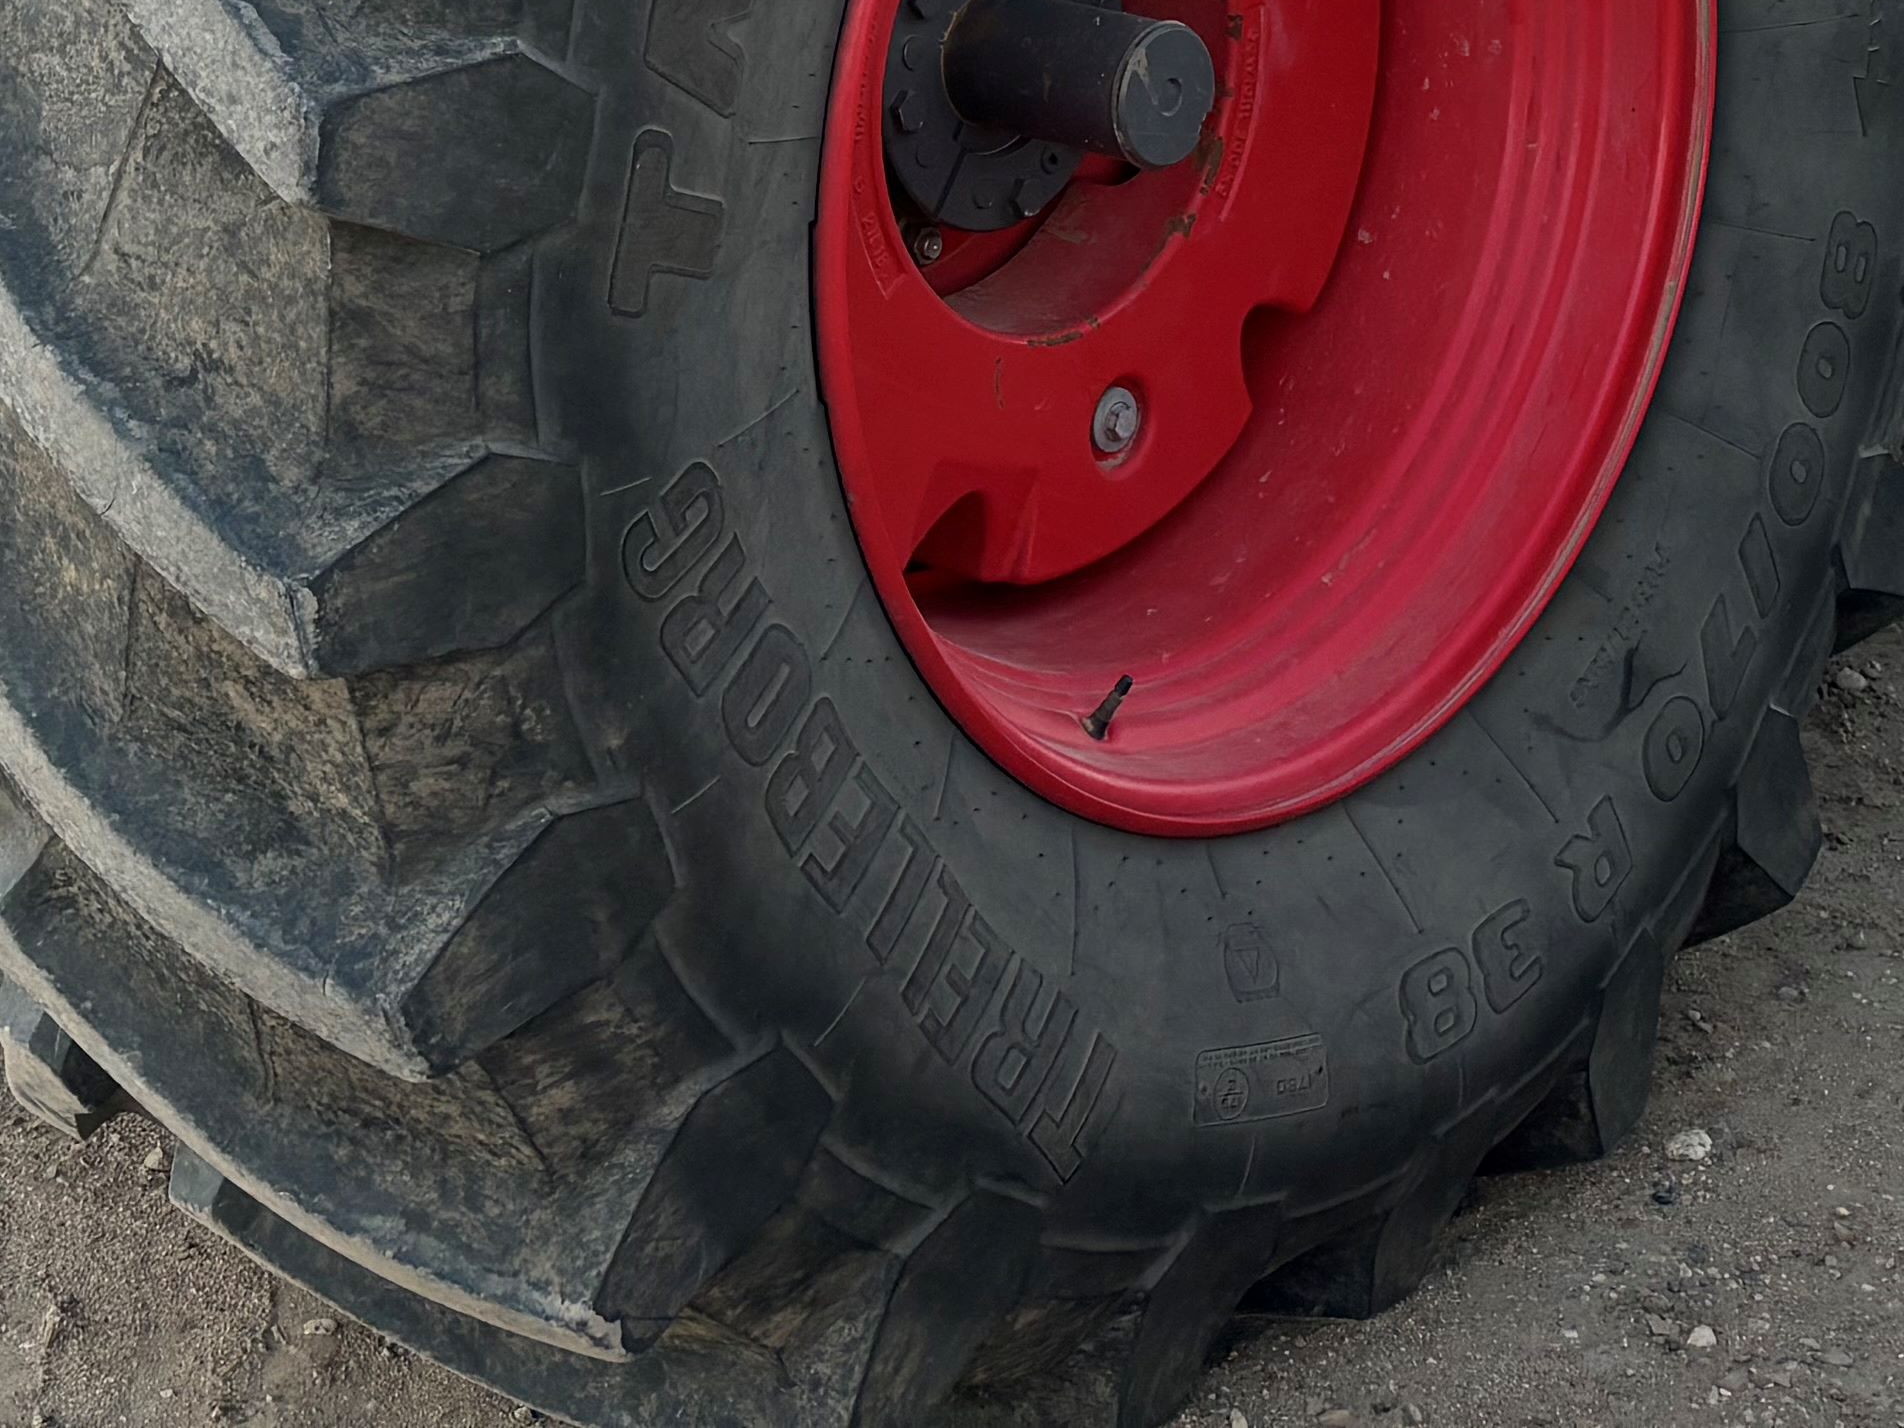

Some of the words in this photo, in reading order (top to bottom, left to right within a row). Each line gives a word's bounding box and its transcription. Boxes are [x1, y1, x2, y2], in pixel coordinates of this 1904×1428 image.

[1642, 209, 1879, 804] 800/70
[620, 459, 1119, 1186] TRELLEBORG
[1397, 897, 1545, 1067] 38
[1553, 794, 1634, 925] R
